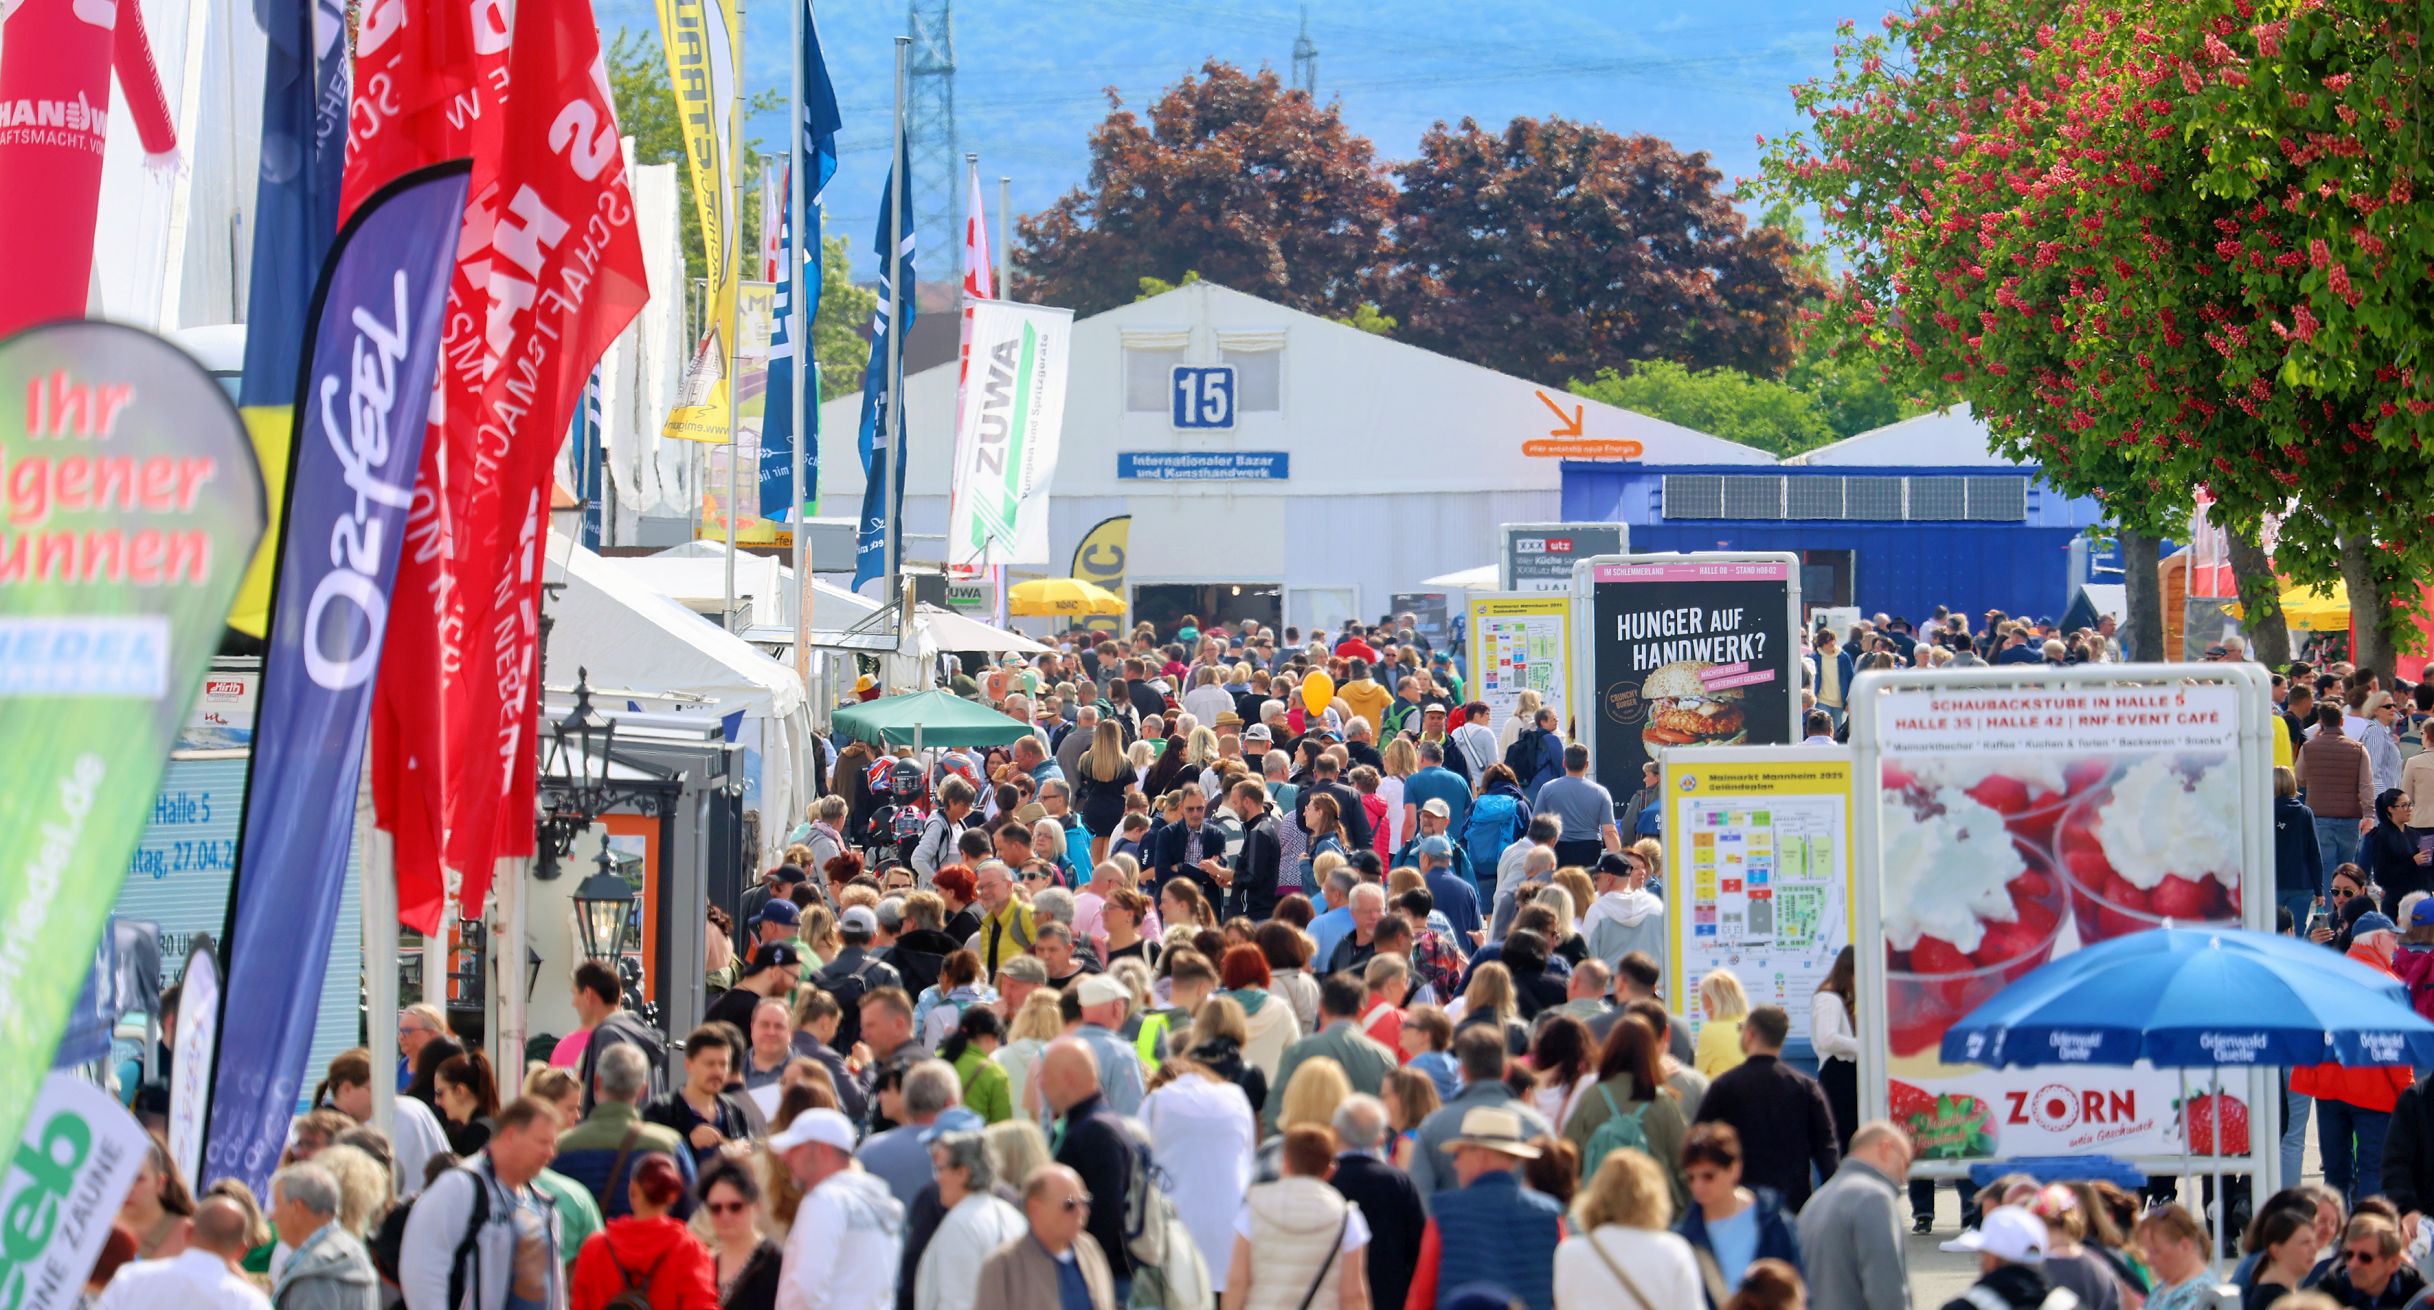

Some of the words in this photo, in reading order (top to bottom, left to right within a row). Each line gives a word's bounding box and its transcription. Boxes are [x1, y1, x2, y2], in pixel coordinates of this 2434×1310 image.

[26, 369, 133, 438] Ihr
[976, 337, 1019, 475] ZUWA
[1178, 371, 1228, 423] 15
[1030, 413, 1038, 442] und
[1132, 455, 1233, 467] Internationaler
[1235, 455, 1274, 467] Bazar
[1136, 467, 1161, 478] und
[1164, 467, 1270, 478] Kunsthandwerk
[0, 454, 214, 526] gener
[1603, 568, 1611, 577] IM
[1612, 567, 1664, 576] SCHLEMMERLAND
[1699, 566, 1719, 575] HALLE
[1735, 566, 1755, 575] STAND
[949, 587, 982, 599] UWA
[1617, 607, 1703, 641] HUNGER
[1709, 608, 1744, 633] AUF
[1632, 632, 1767, 671] HANDWERK?
[1708, 677, 1743, 689] MEISTERHAFT
[1743, 672, 1771, 681] GEBACKEN
[1610, 689, 1638, 703] CRUNCHY
[1930, 698, 2087, 712] SCHAUBACKSTUBE
[2093, 697, 2110, 708] IN
[2116, 696, 2168, 707] HALLE
[2175, 694, 2185, 706] 5
[1895, 718, 1947, 730] HALLE
[1954, 718, 1972, 729] 35
[1986, 716, 2038, 728] HALLE
[2044, 716, 2063, 727] 42
[2078, 712, 2170, 726] RNF-EVENT
[2176, 709, 2219, 725] CAFÉ
[1983, 740, 2015, 749] Kaffee
[2025, 739, 2063, 749] Kuchen
[2119, 736, 2175, 747] Backwaren
[2184, 735, 2222, 745] Snacks
[1708, 773, 1760, 782] Maimarkt
[1762, 772, 1817, 781] Mannheim
[1819, 772, 1844, 780] 2025
[155, 791, 197, 825] Halle
[201, 792, 211, 823] 5
[129, 846, 168, 880] ntag,
[2200, 1032, 2267, 1050] Odenwald
[2213, 1048, 2255, 1062] Quelle
[2005, 1084, 2136, 1132] ZORN
